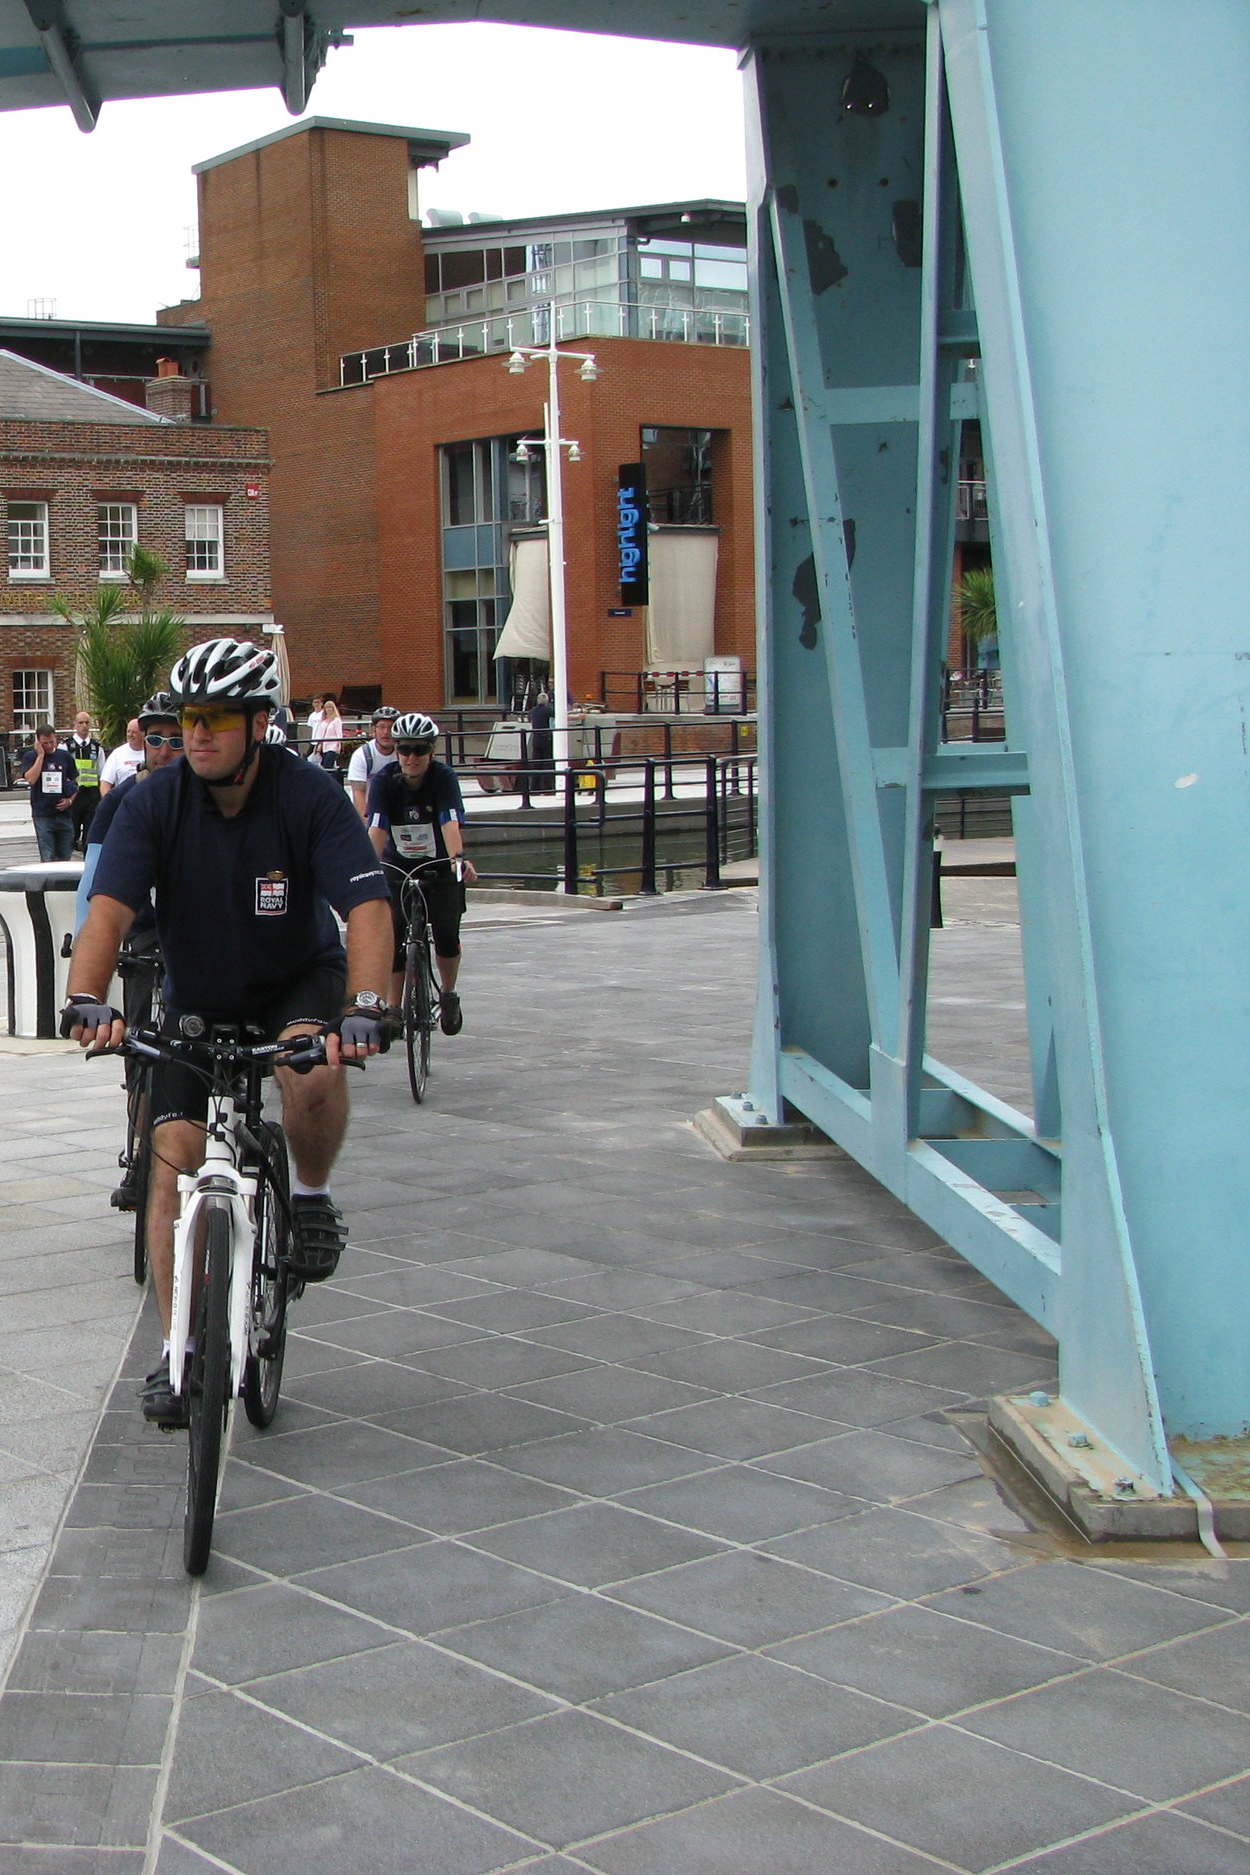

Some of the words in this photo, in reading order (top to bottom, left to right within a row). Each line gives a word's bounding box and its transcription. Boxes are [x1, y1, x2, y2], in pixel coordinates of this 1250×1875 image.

[617, 487, 641, 583] highlight
[260, 896, 284, 904] ROYAL
[260, 902, 284, 910] NAVY
